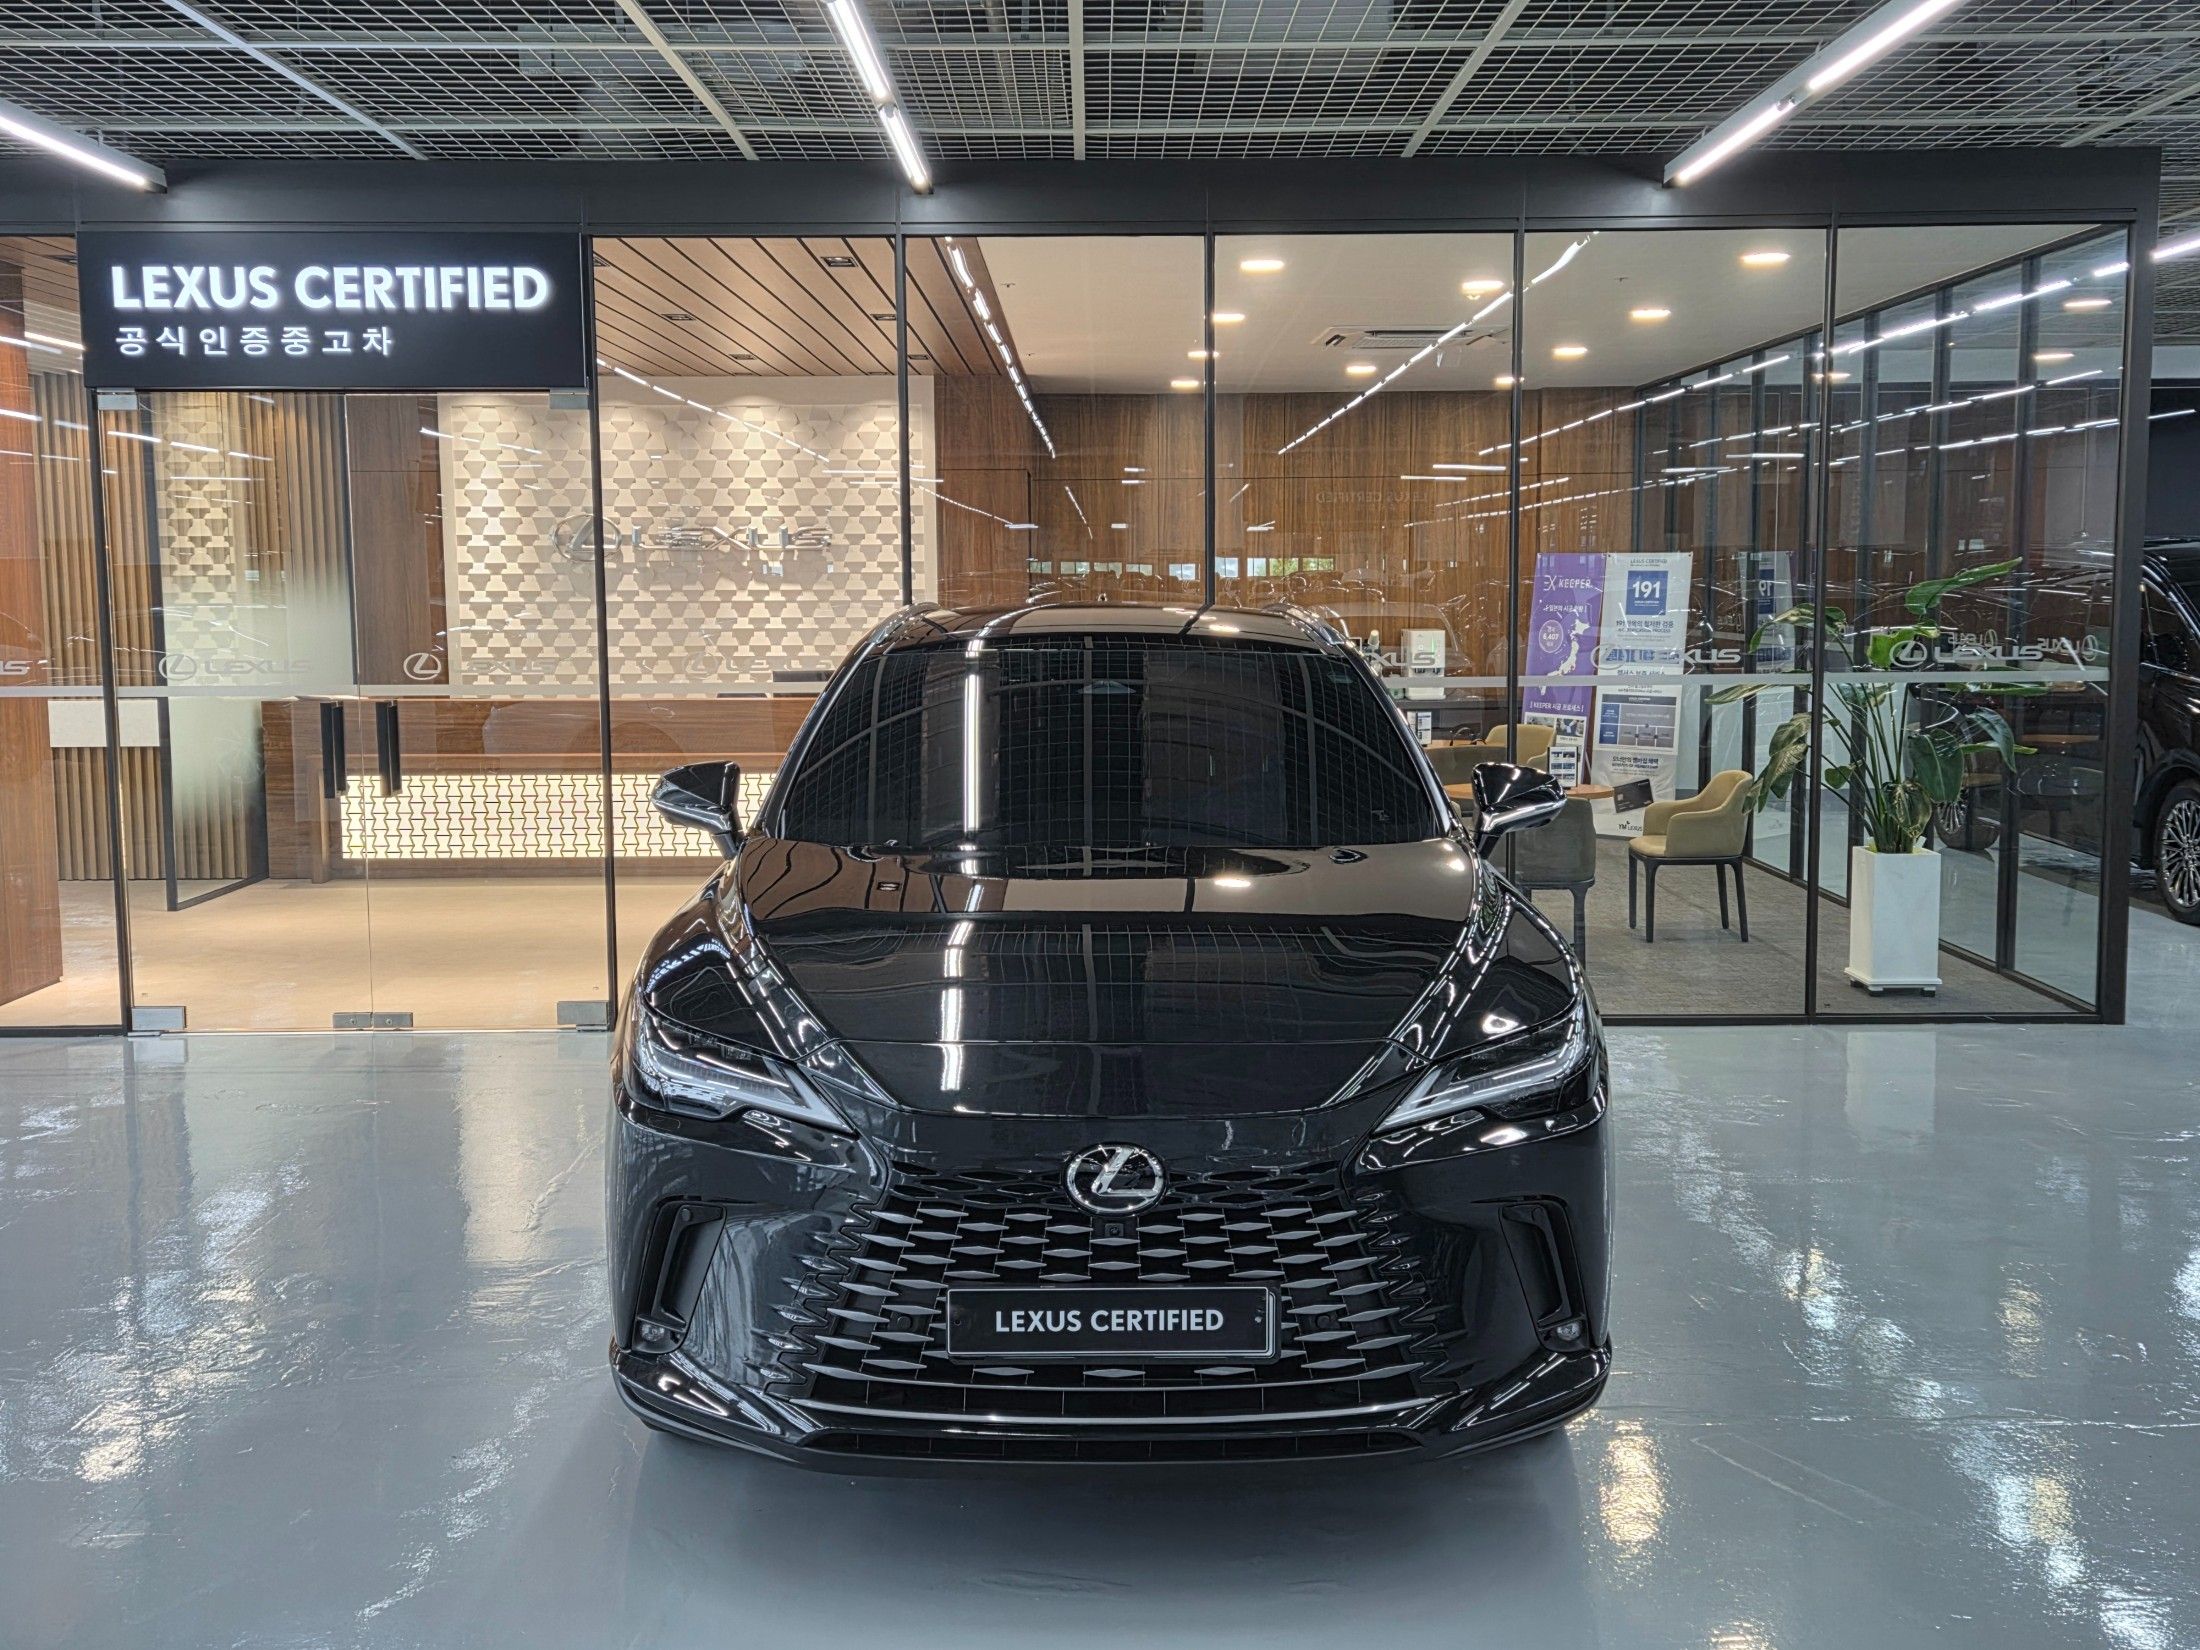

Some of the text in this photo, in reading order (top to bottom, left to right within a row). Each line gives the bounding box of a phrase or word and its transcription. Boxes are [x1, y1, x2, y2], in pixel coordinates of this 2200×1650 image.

[111, 265, 550, 309] LEXUS CERTIFIED
[115, 326, 392, 356] 공식인증중고차
[632, 525, 832, 551] LEXUS
[1558, 578, 1591, 589] KEEPER
[1632, 580, 1661, 598] 191
[1934, 645, 2044, 661] LEXUS
[204, 659, 312, 675] LEXUS
[995, 1309, 1224, 1332] LEXUS CERTIFIED
